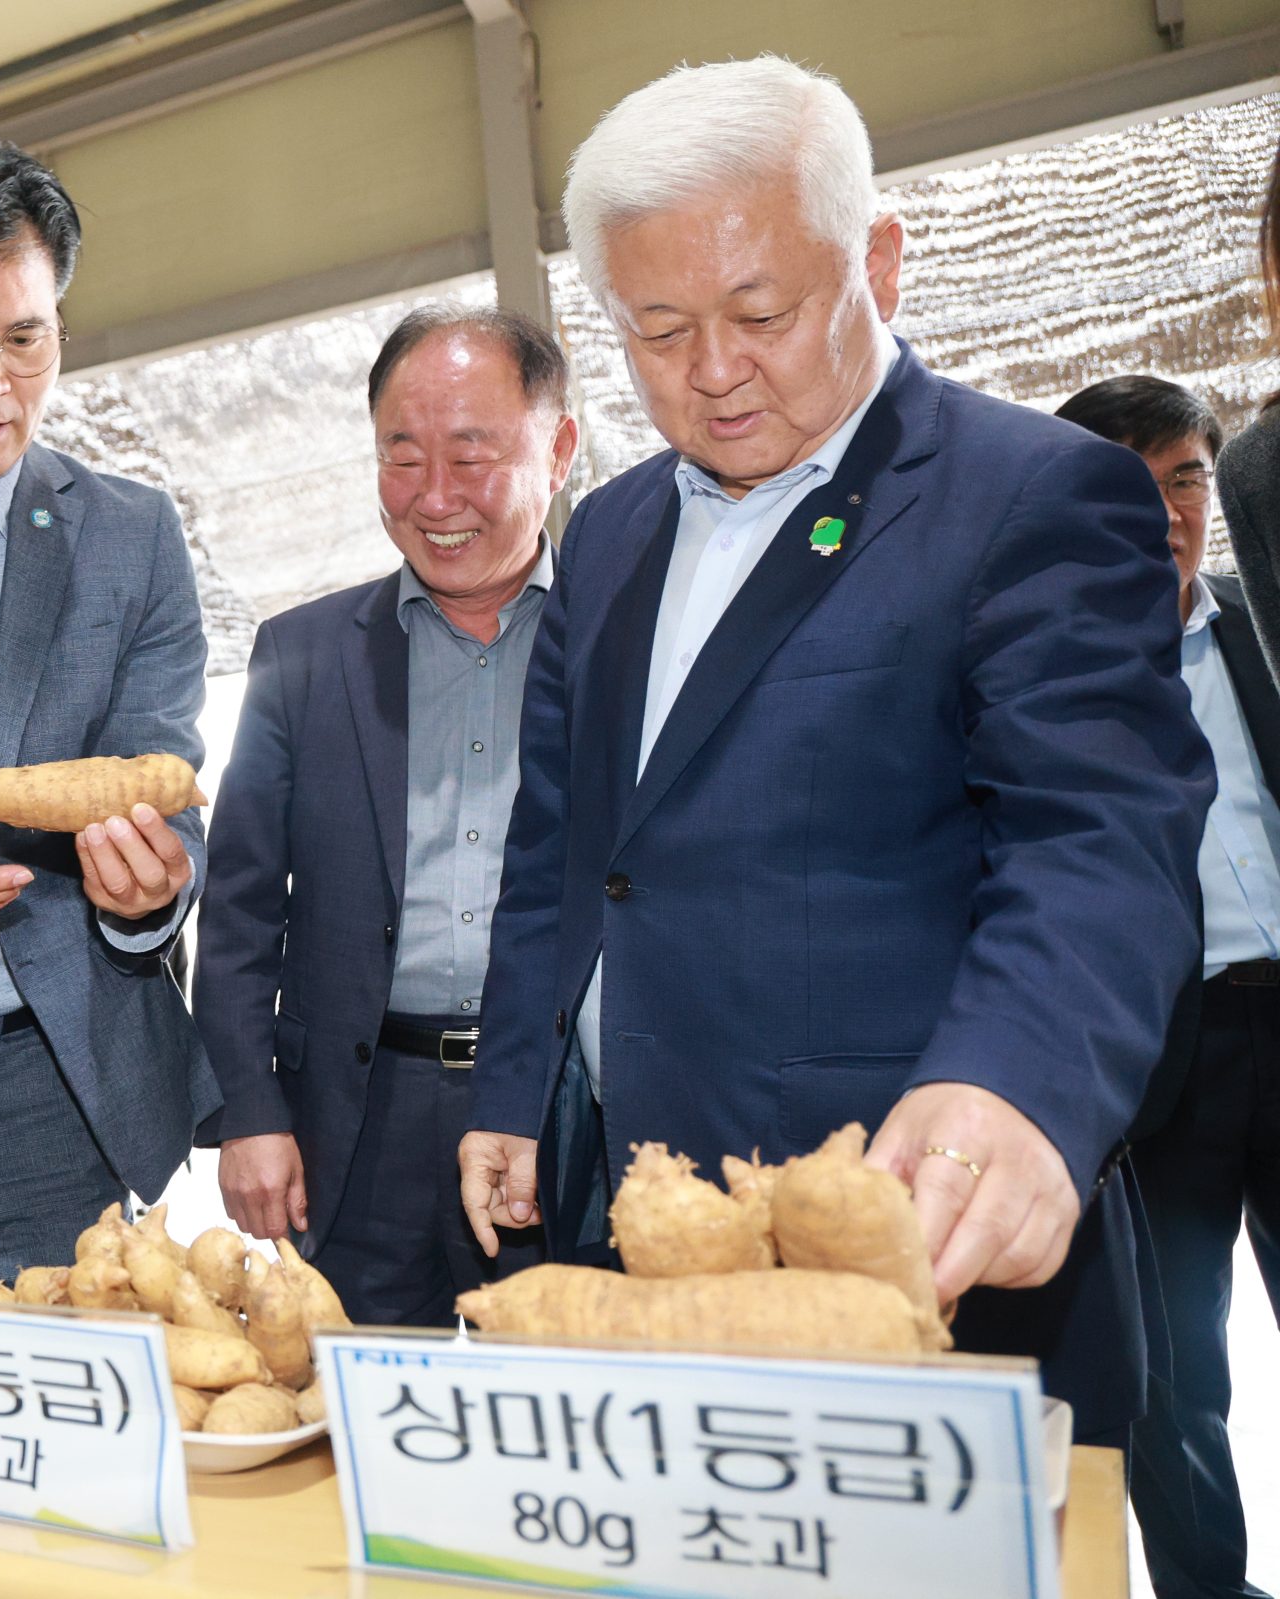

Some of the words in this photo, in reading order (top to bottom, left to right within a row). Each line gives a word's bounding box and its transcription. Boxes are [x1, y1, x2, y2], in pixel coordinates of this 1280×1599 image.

[378, 1382, 978, 1512] 상마(1등급)
[511, 1491, 637, 1567] 80g
[680, 1505, 837, 1580] 초과
